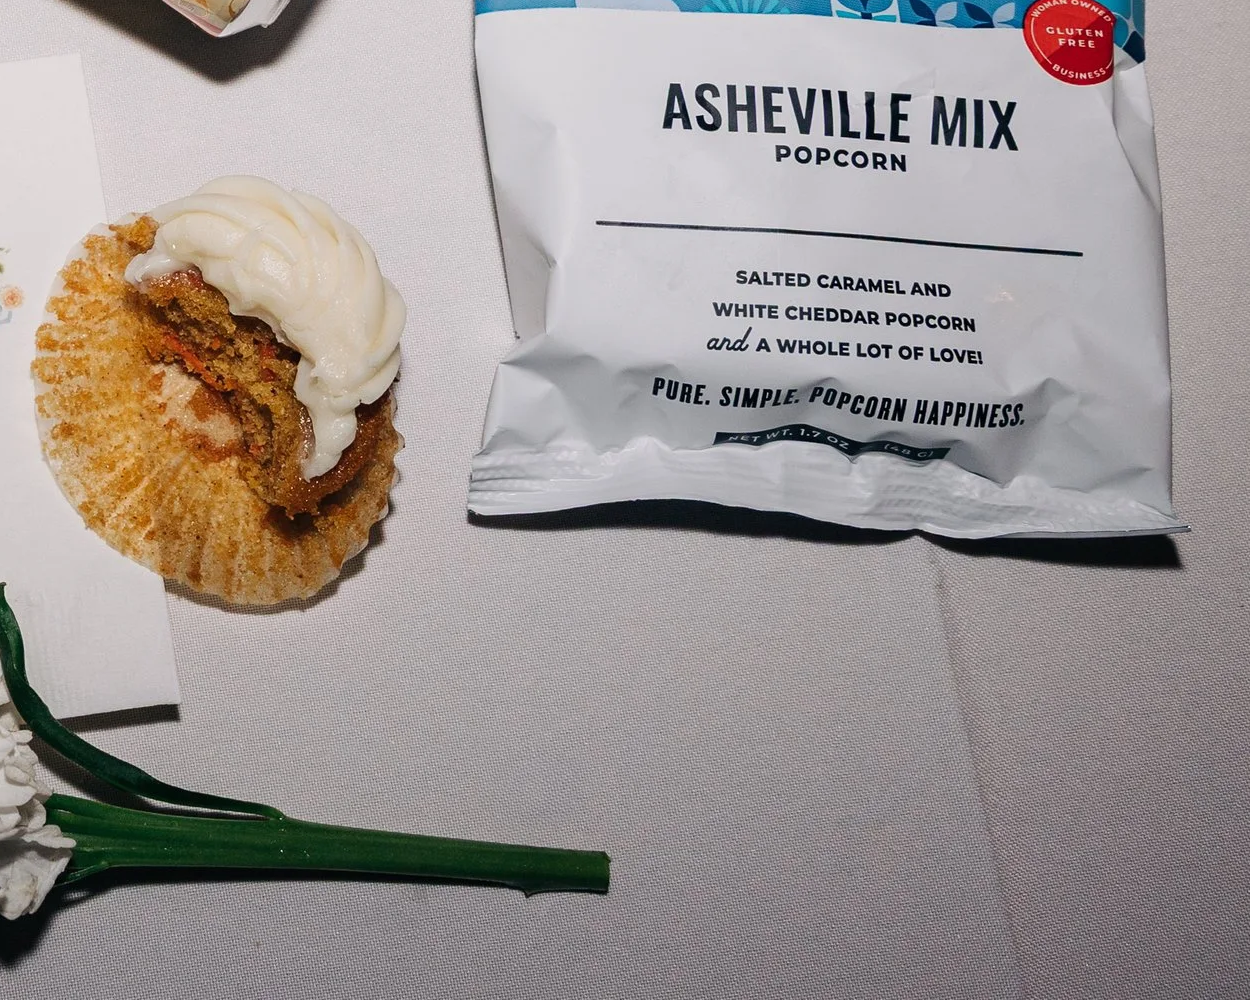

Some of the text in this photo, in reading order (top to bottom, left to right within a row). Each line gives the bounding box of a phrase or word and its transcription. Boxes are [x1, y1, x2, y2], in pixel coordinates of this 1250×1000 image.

[1031, 0, 1111, 24] WOMAN OWNED
[1046, 27, 1103, 39] GLUTEN
[1058, 38, 1094, 48] FREE
[1052, 63, 1107, 80] BUSINESS
[662, 82, 1018, 151] ASHEVILLE MIX
[775, 144, 907, 173] POPCORN
[736, 271, 951, 297] SALTED CARAMEL AND
[713, 302, 975, 332] WHITE CHEDDAR POPCORN
[707, 327, 983, 364] and A WHOLE LOT OF LOVE!
[653, 378, 1024, 427] PURE. SIMPLE. POPCORN HAPPINESS.
